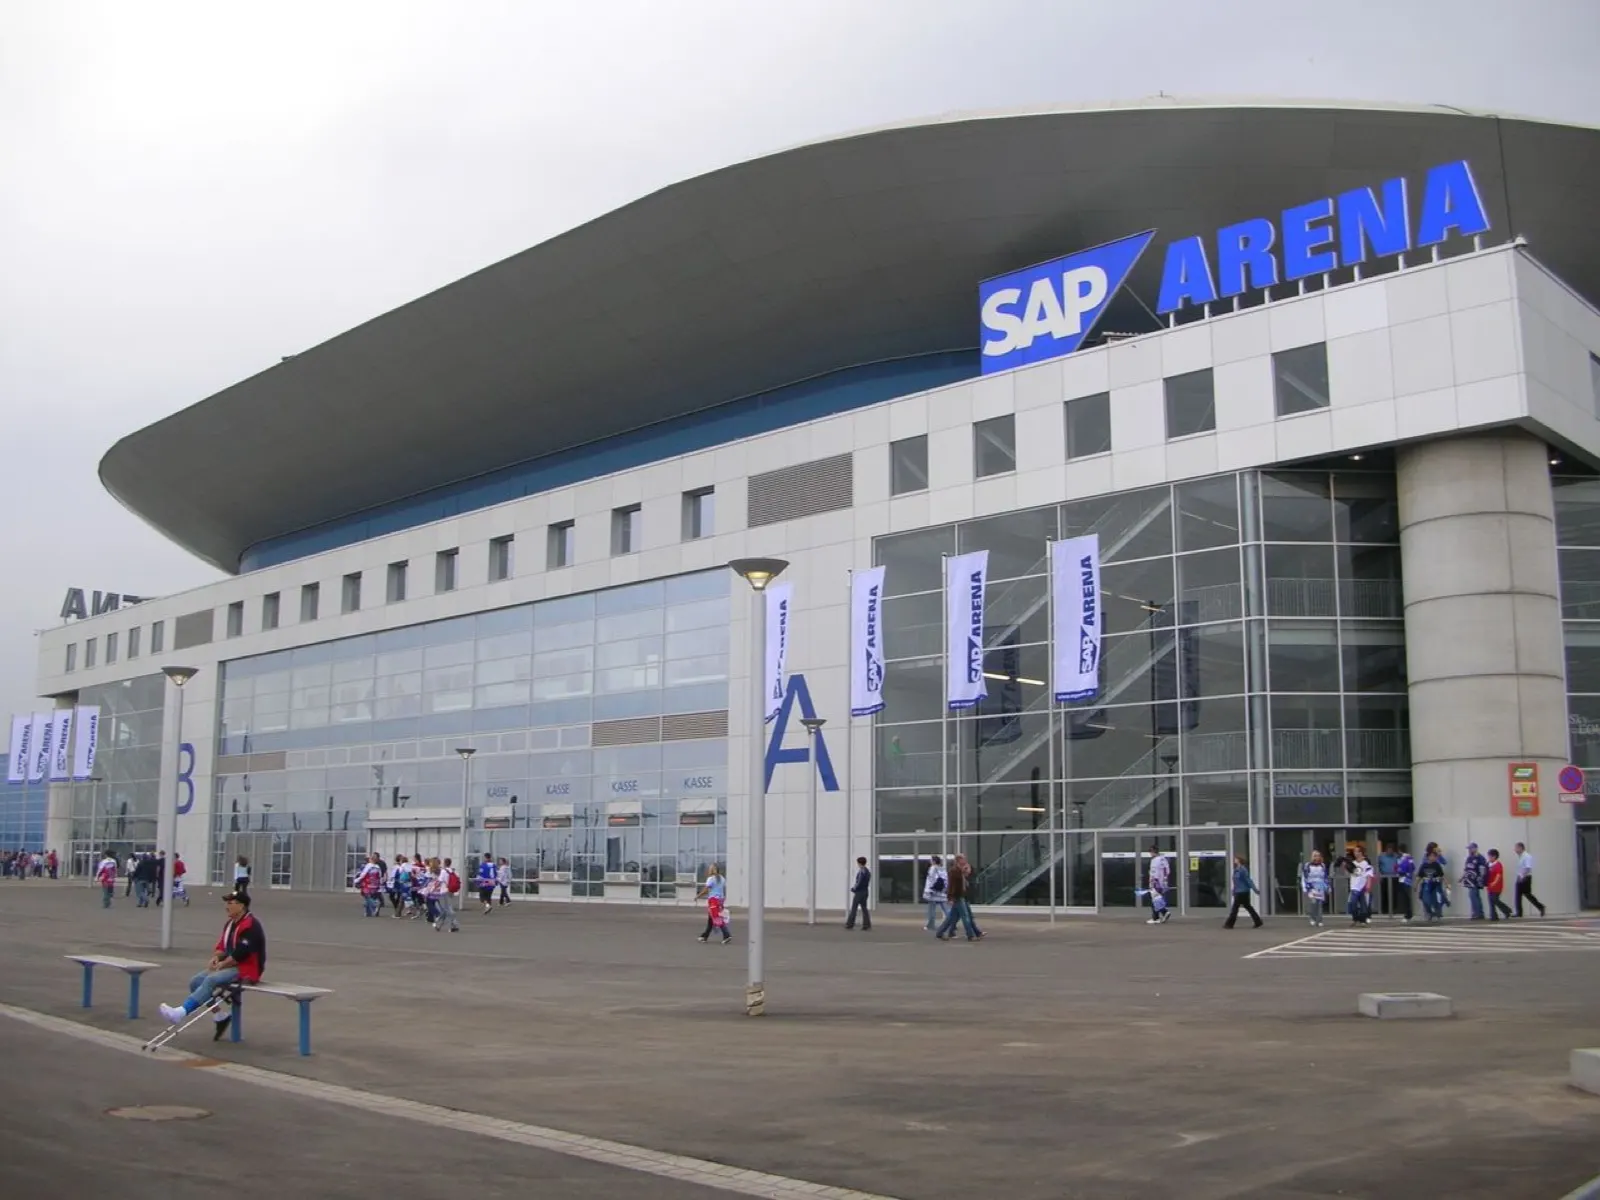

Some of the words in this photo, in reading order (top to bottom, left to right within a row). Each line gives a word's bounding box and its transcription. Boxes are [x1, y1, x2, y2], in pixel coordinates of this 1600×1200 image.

[980, 264, 1108, 356] SAP
[1155, 159, 1492, 315] ARENA
[970, 570, 982, 637] ARENA
[1080, 555, 1095, 626] ARENA
[867, 584, 879, 648] ARENA
[764, 674, 840, 794] A
[487, 786, 509, 797] KASSE
[546, 783, 570, 794] KASSE
[611, 780, 638, 792] KASSE
[684, 776, 713, 789] KASSE
[1275, 783, 1342, 796] EINGANG
